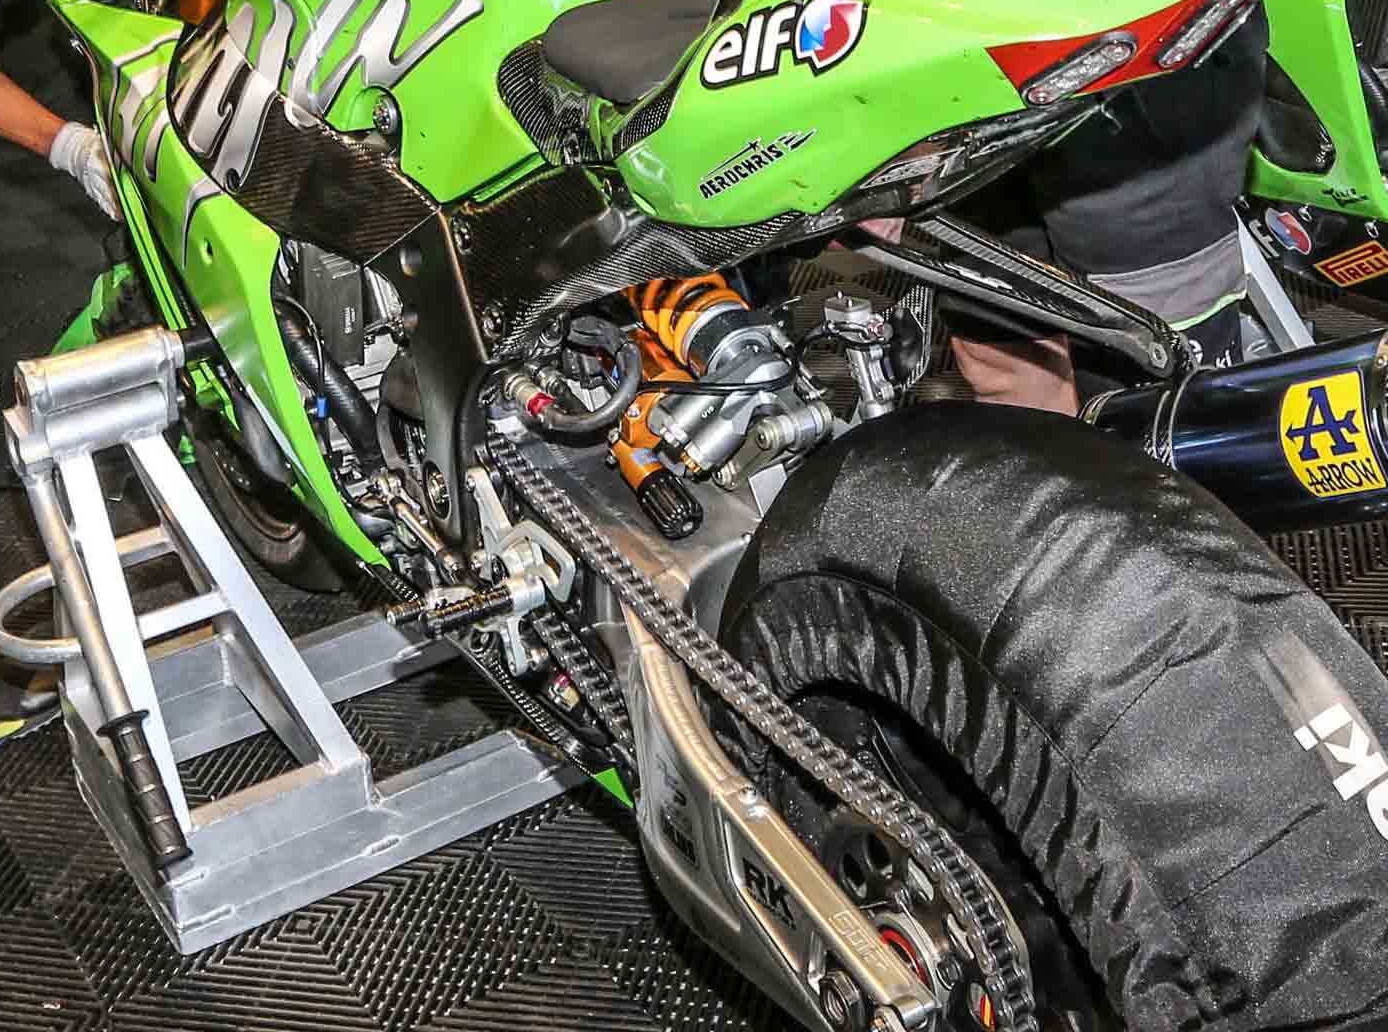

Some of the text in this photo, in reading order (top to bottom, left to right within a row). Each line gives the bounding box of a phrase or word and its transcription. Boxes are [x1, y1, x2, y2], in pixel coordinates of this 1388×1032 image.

[703, 4, 798, 85] elf
[699, 145, 783, 200] AEROCHRIS
[1307, 456, 1384, 497] ARROW
